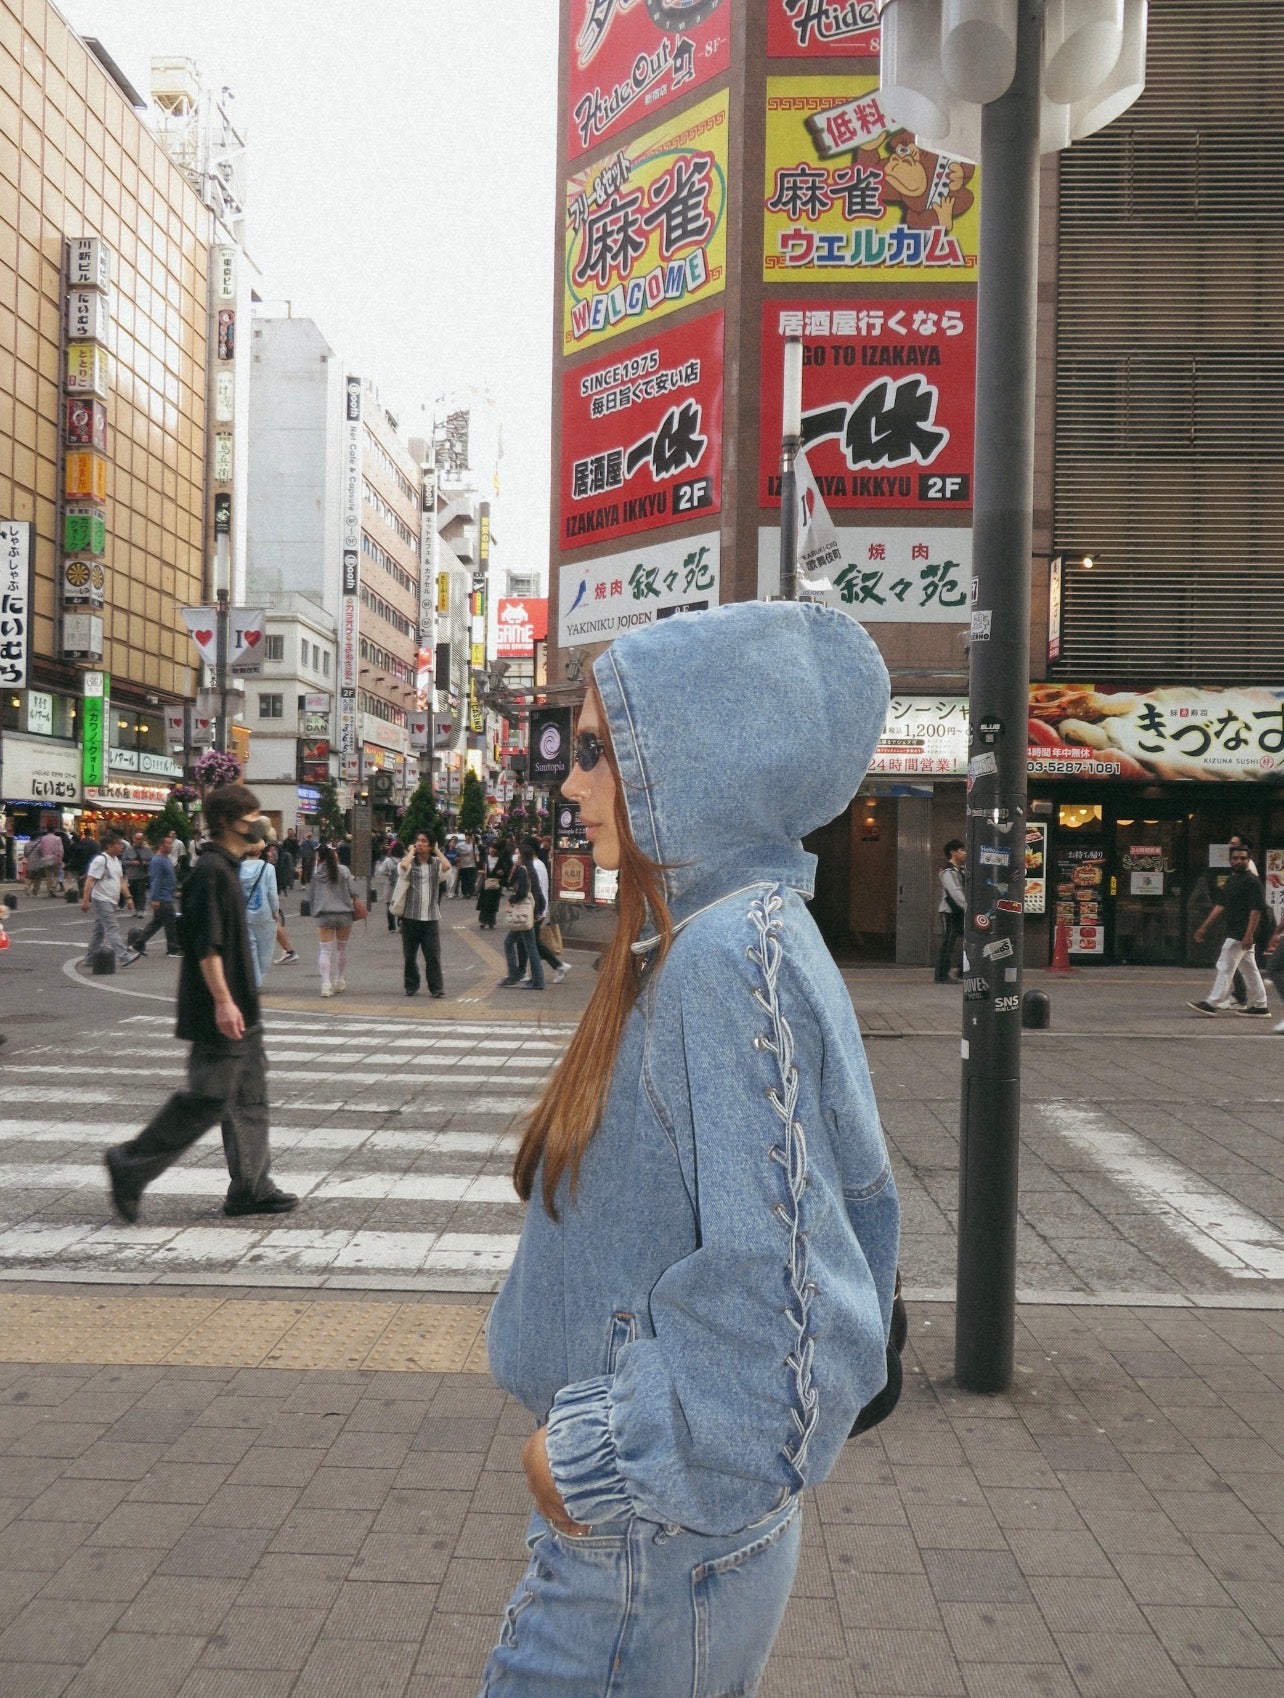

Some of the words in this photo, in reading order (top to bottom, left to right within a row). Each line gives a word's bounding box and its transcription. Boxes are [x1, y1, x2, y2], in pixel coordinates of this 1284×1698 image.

[769, 165, 884, 219] 麻雀
[576, 156, 711, 286] 麻雀
[78, 240, 91, 283] 川新ビル
[572, 252, 702, 332] WELCOME
[77, 294, 89, 335] にいむら
[778, 310, 964, 337] 居酒屋行くなら
[831, 345, 856, 366] TO
[862, 345, 942, 366] IZAKAYA
[591, 360, 700, 418] 毎日旨くて安い店
[801, 373, 950, 470] 一休
[852, 476, 911, 497] IKKYU
[927, 477, 962, 498] 2F
[566, 502, 620, 538] IZAKAYA
[623, 491, 667, 523] IKKYU
[679, 481, 706, 510] 2F
[8, 526, 20, 591] しゃぶしゃぶ
[806, 548, 842, 571] 歌舞伎町
[868, 543, 929, 560] 焼肉
[628, 546, 716, 601] 叙々苑
[834, 560, 967, 608] 叙々苑
[595, 579, 623, 600] 焼肉
[567, 618, 615, 636] YAKINIKU
[617, 612, 652, 630] JOJOEN
[0, 594, 24, 682] にいむら
[235, 630, 243, 648] I
[472, 705, 482, 730] CASINO
[1137, 702, 1284, 757] きづなす
[1052, 748, 1090, 758] 年中無休
[535, 761, 565, 773] Suutopia
[1027, 761, 1120, 774] 03-5287-1081
[32, 779, 76, 797] にいむら
[995, 995, 1019, 1007] SNS
